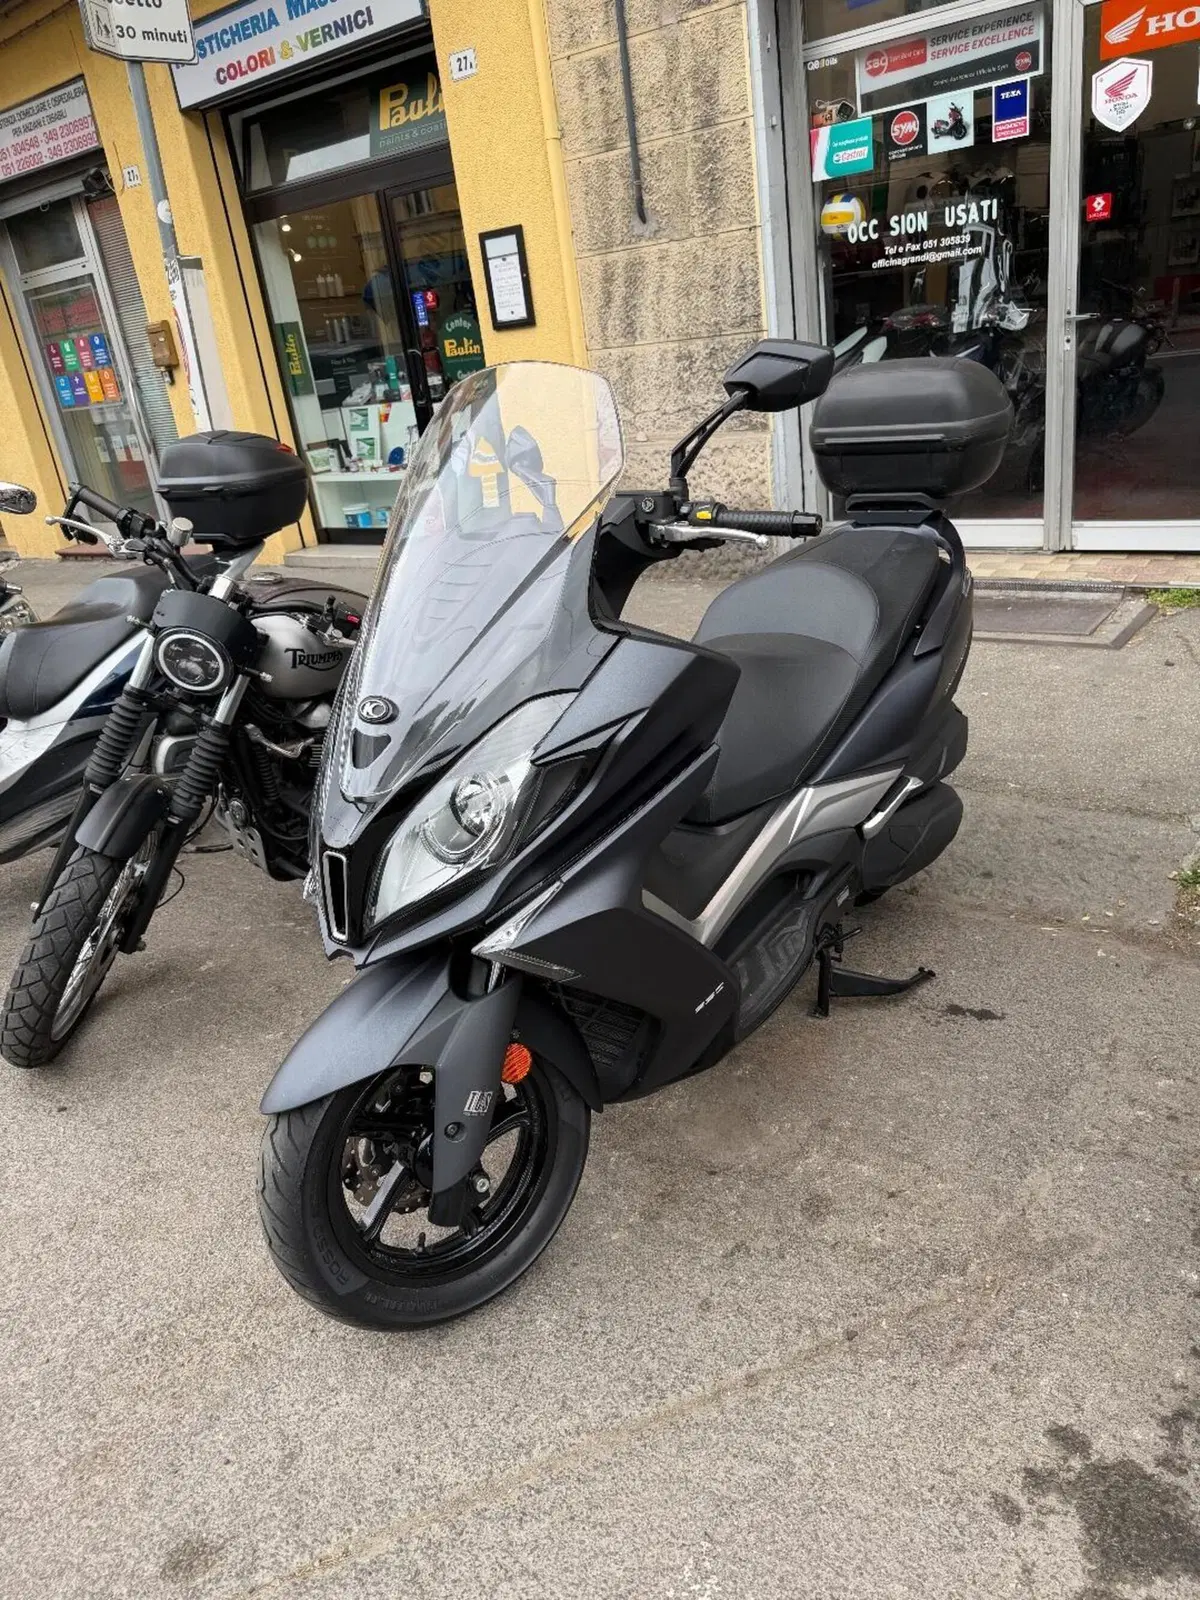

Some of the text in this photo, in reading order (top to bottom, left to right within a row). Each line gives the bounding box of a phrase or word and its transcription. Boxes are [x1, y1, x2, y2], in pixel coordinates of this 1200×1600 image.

[116, 25, 188, 43] 30 minuti
[930, 11, 1035, 47] SERVICE EXPERIENCE,
[216, 6, 374, 85] COLORI & VERNICI
[930, 45, 969, 61] SERVICE
[971, 25, 1035, 50] EXCELLENCE
[1000, 90, 1021, 99] TEXA
[1105, 92, 1138, 104] HONDA
[12, 126, 22, 137] PER
[411, 129, 419, 138] &
[892, 121, 918, 138] SYM
[0, 147, 11, 160] 51
[11, 136, 40, 156] 304548
[43, 128, 59, 144] 349
[1, 163, 16, 178] 051
[17, 151, 44, 172] 226002
[47, 144, 63, 160] 349
[945, 199, 998, 227] USATI
[884, 246, 897, 255] Tel
[905, 243, 920, 252] Fax
[923, 240, 937, 250] 051
[940, 234, 971, 247] 305839
[872, 246, 982, 269] officinagrandi@gmail.com
[444, 337, 481, 357] Paulin
[284, 648, 343, 671] TRIUMPH
